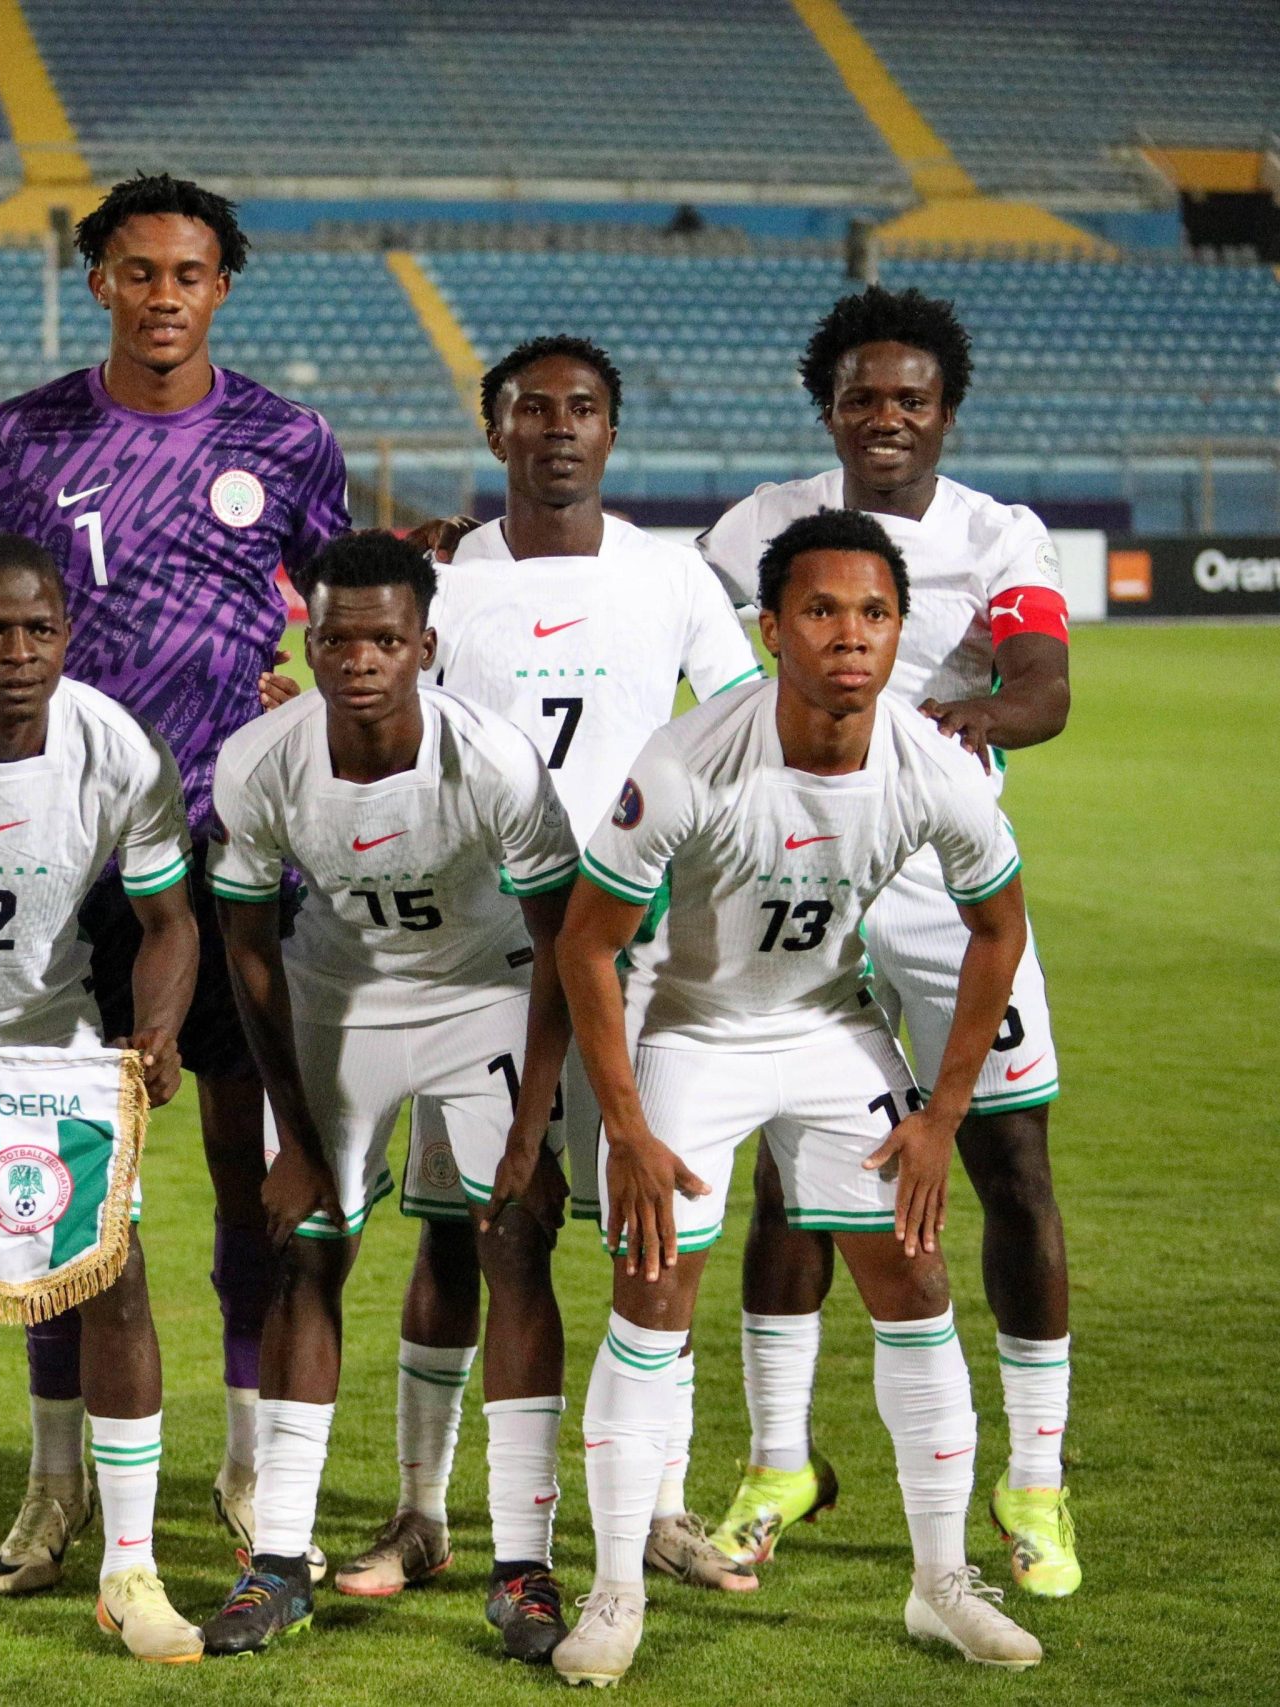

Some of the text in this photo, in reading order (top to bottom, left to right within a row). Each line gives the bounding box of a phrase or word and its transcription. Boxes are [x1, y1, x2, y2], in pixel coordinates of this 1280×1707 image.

[74, 511, 109, 586] 1
[515, 668, 607, 678] NAIJA
[542, 697, 583, 769] 7
[349, 889, 443, 932] 15
[758, 900, 834, 952] 13
[44, 1155, 71, 1207] FEDERATION
[15, 1224, 37, 1233] 1945
